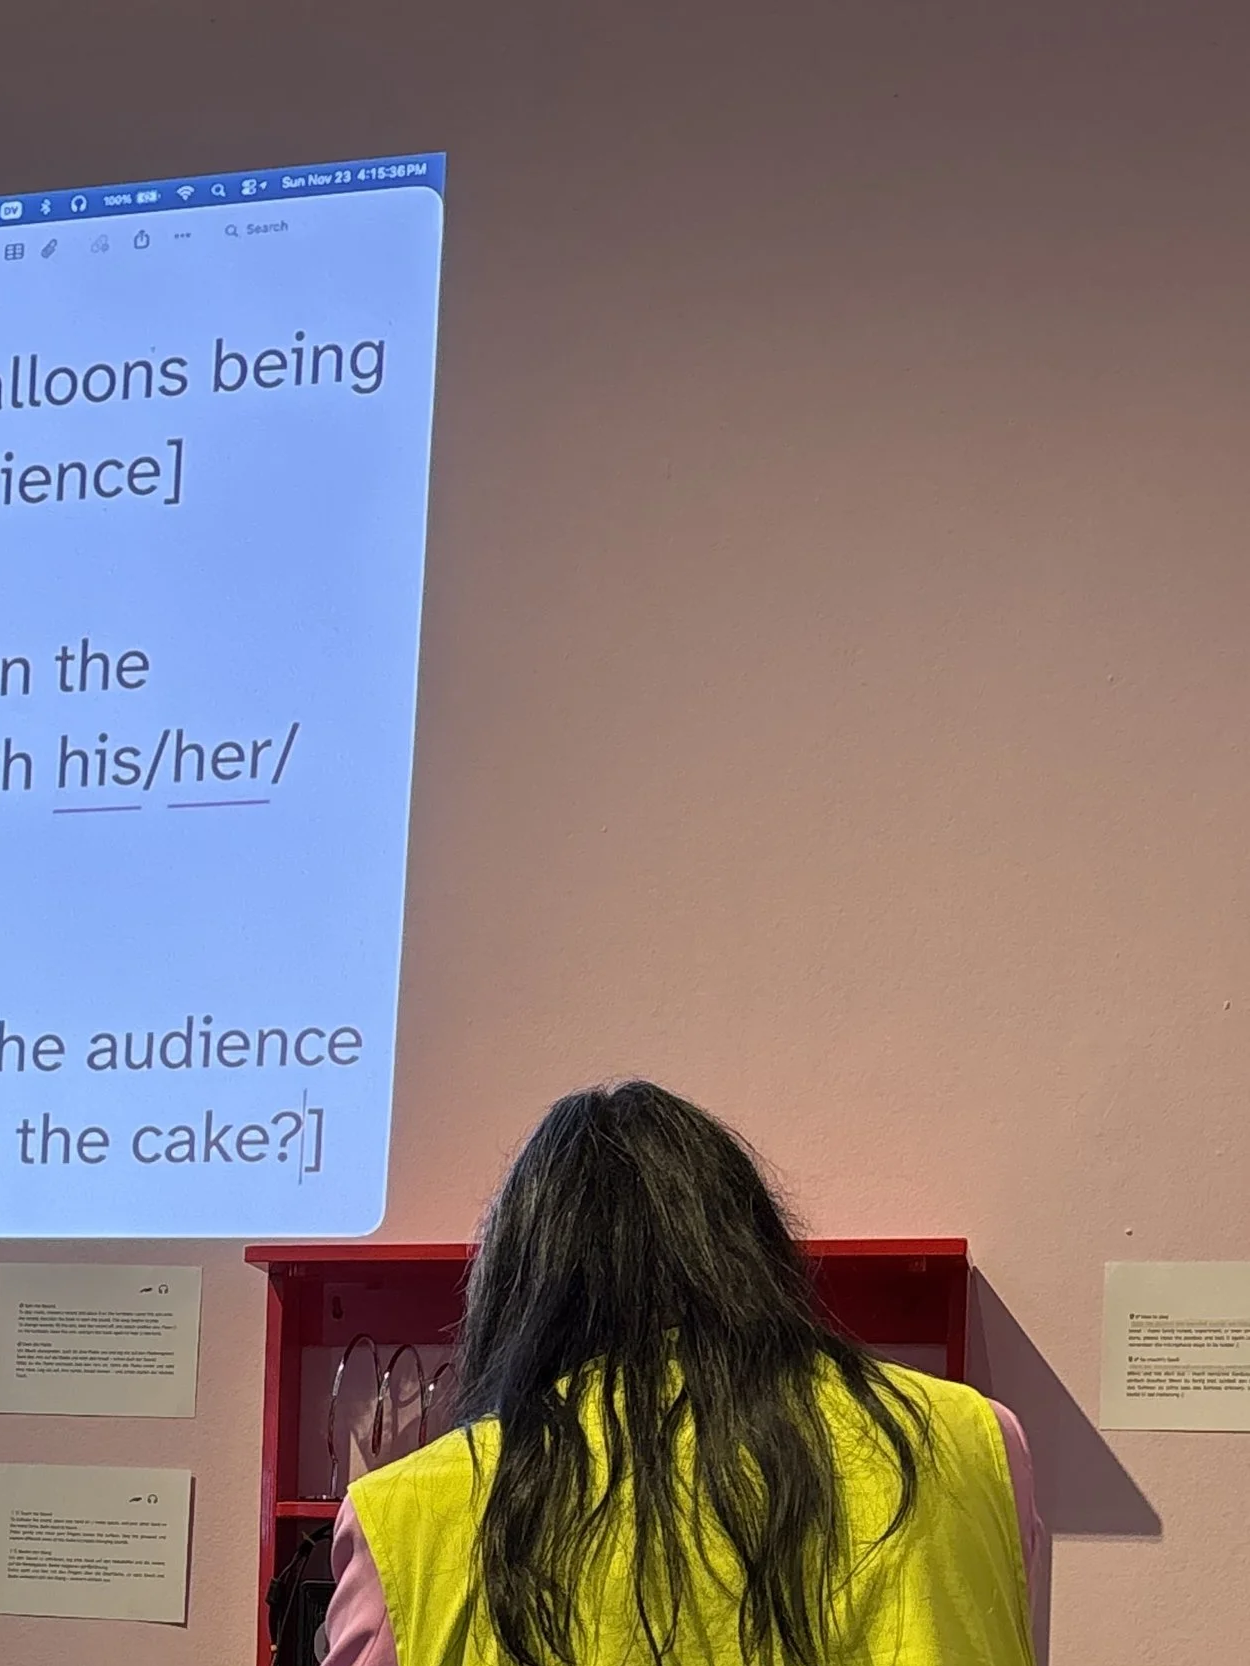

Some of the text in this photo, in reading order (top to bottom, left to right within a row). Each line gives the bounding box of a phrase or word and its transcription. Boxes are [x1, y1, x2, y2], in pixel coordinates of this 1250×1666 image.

[281, 174, 307, 190] Sun
[308, 172, 333, 187] Nov
[334, 170, 352, 185] 23
[245, 220, 290, 236] Search
[212, 330, 386, 395] being
[54, 637, 151, 693] the
[57, 721, 301, 792] his/her/
[85, 1014, 364, 1071] audience
[15, 1111, 110, 1165] the
[131, 1106, 325, 1174] cake?]
